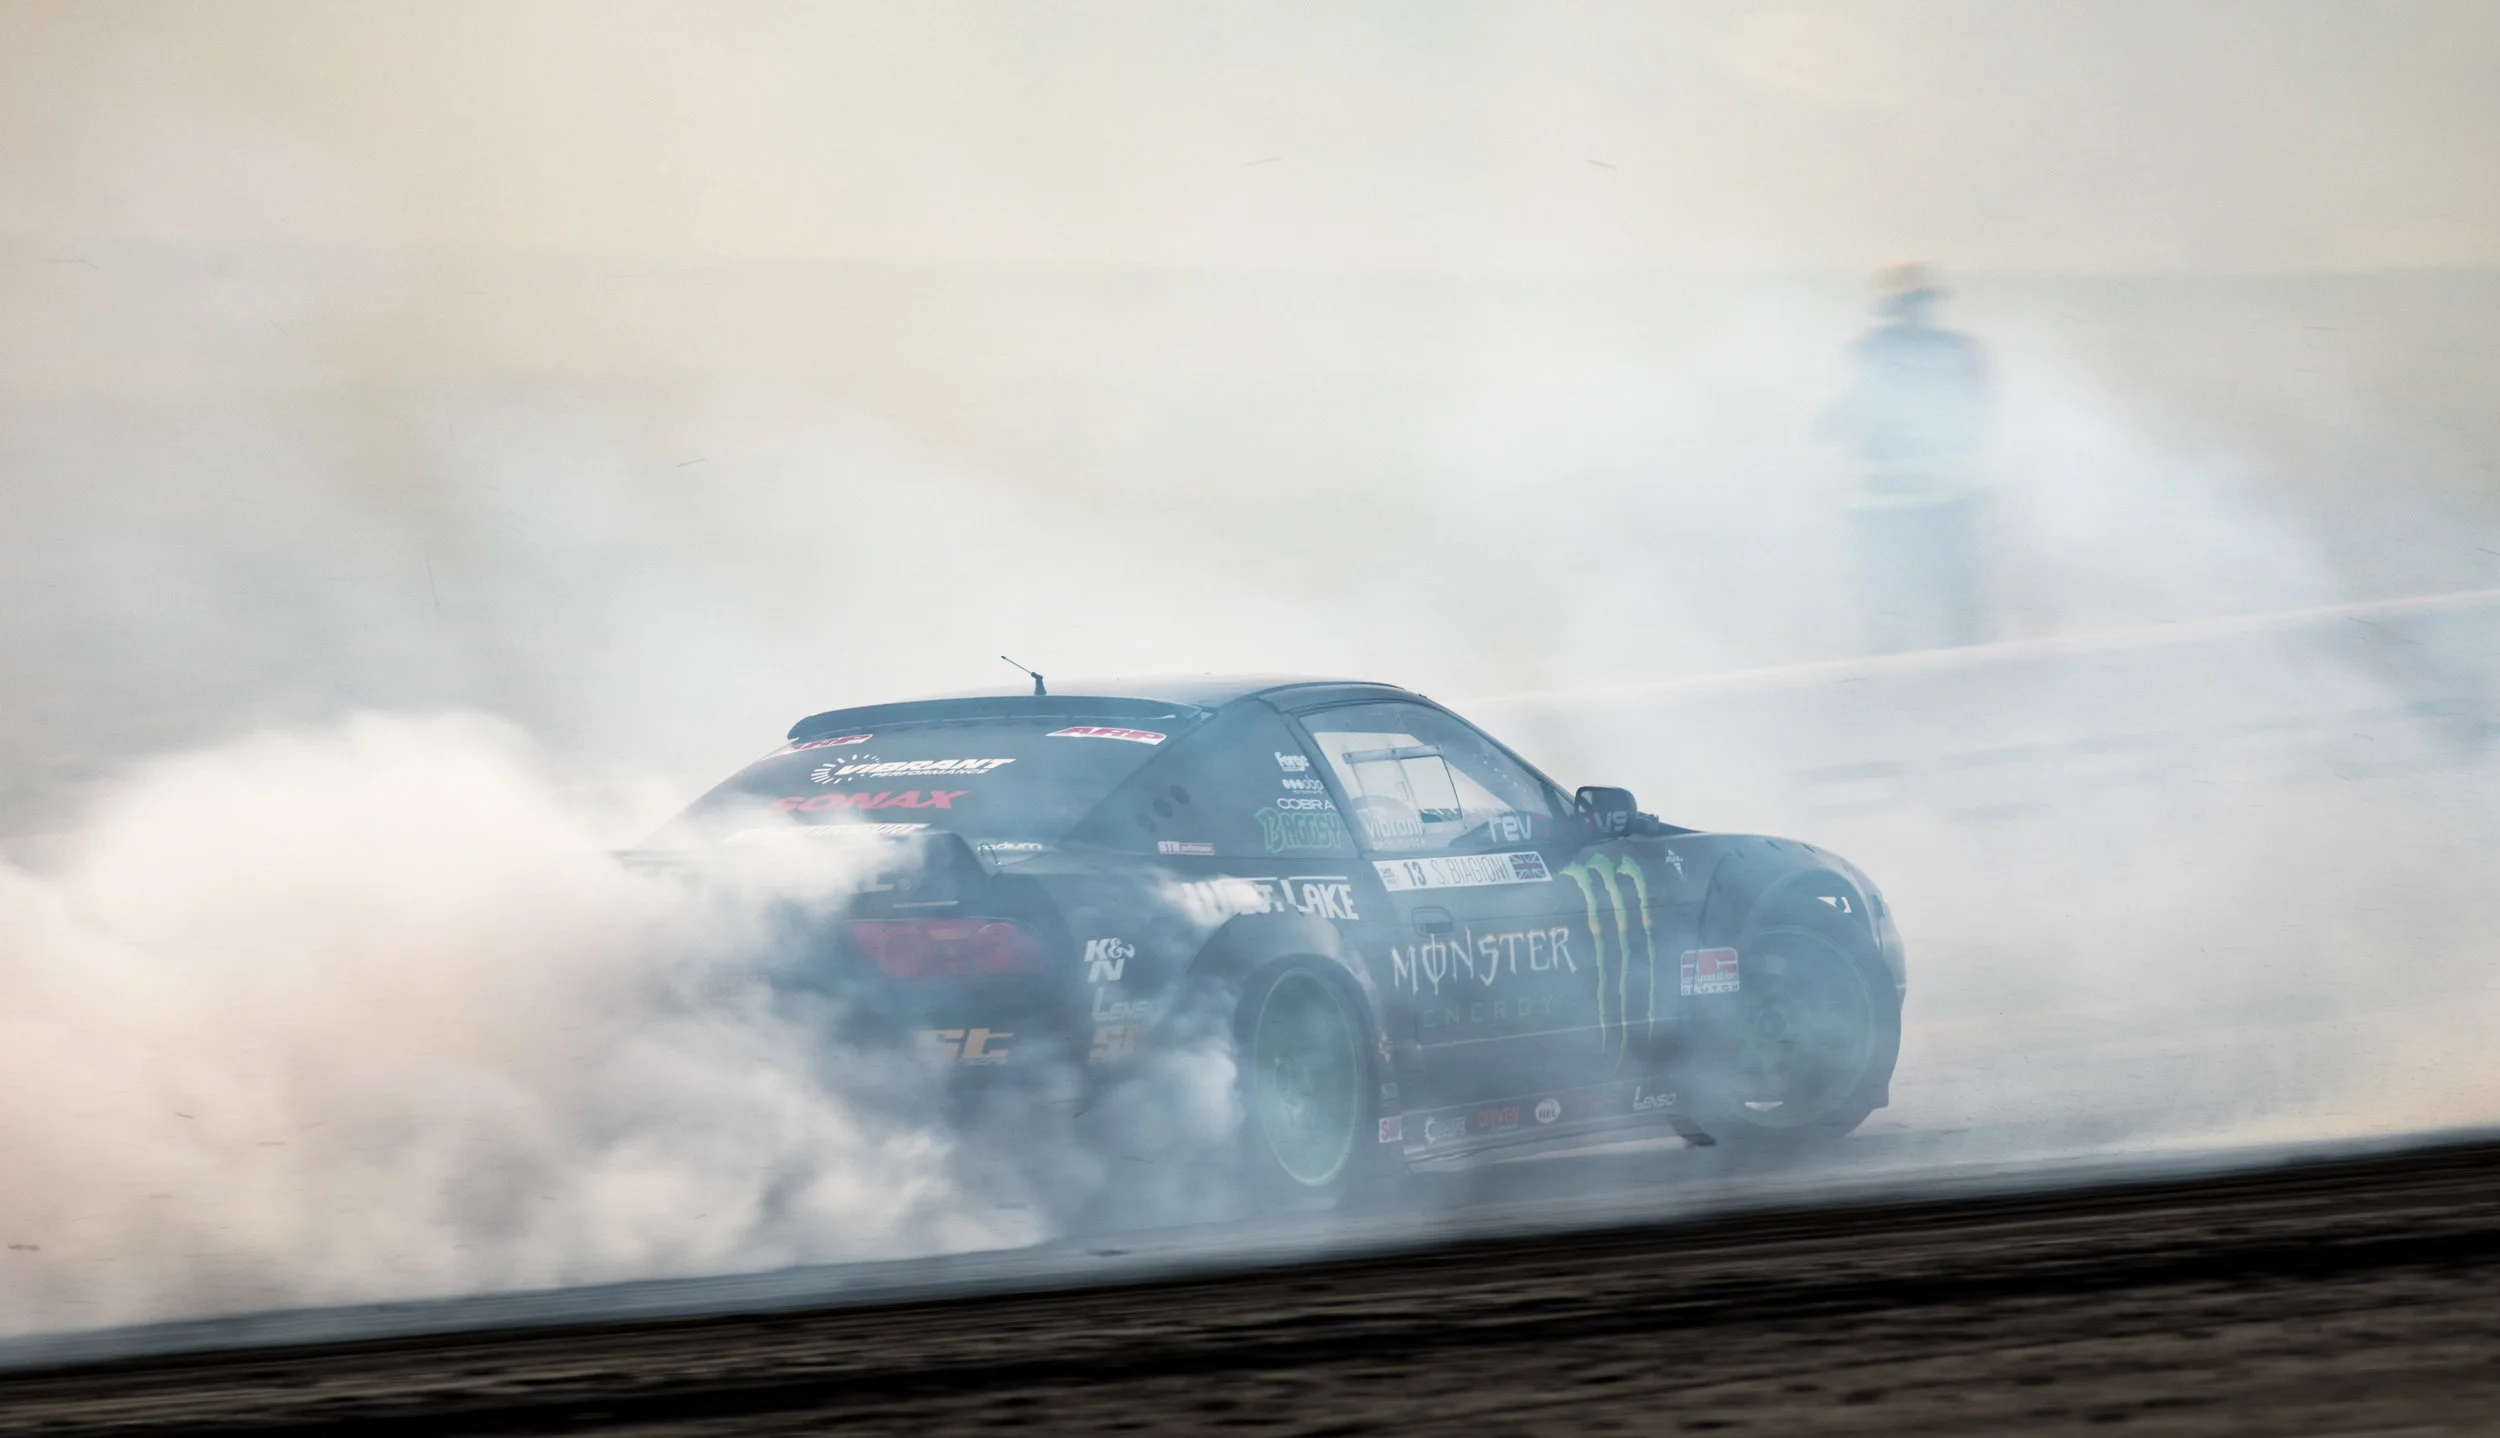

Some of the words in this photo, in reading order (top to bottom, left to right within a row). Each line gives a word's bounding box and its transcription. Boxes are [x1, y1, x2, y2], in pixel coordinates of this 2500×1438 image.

[1058, 727, 1165, 742] ARP
[834, 758, 1015, 775] VIBRANT
[764, 790, 969, 813] SONAX
[1277, 798, 1336, 810] COBRA
[1402, 861, 1427, 887] 13
[1280, 879, 1360, 920] LAKE
[1391, 926, 1577, 996] MONSTER
[1422, 994, 1553, 1027] ENERGY
